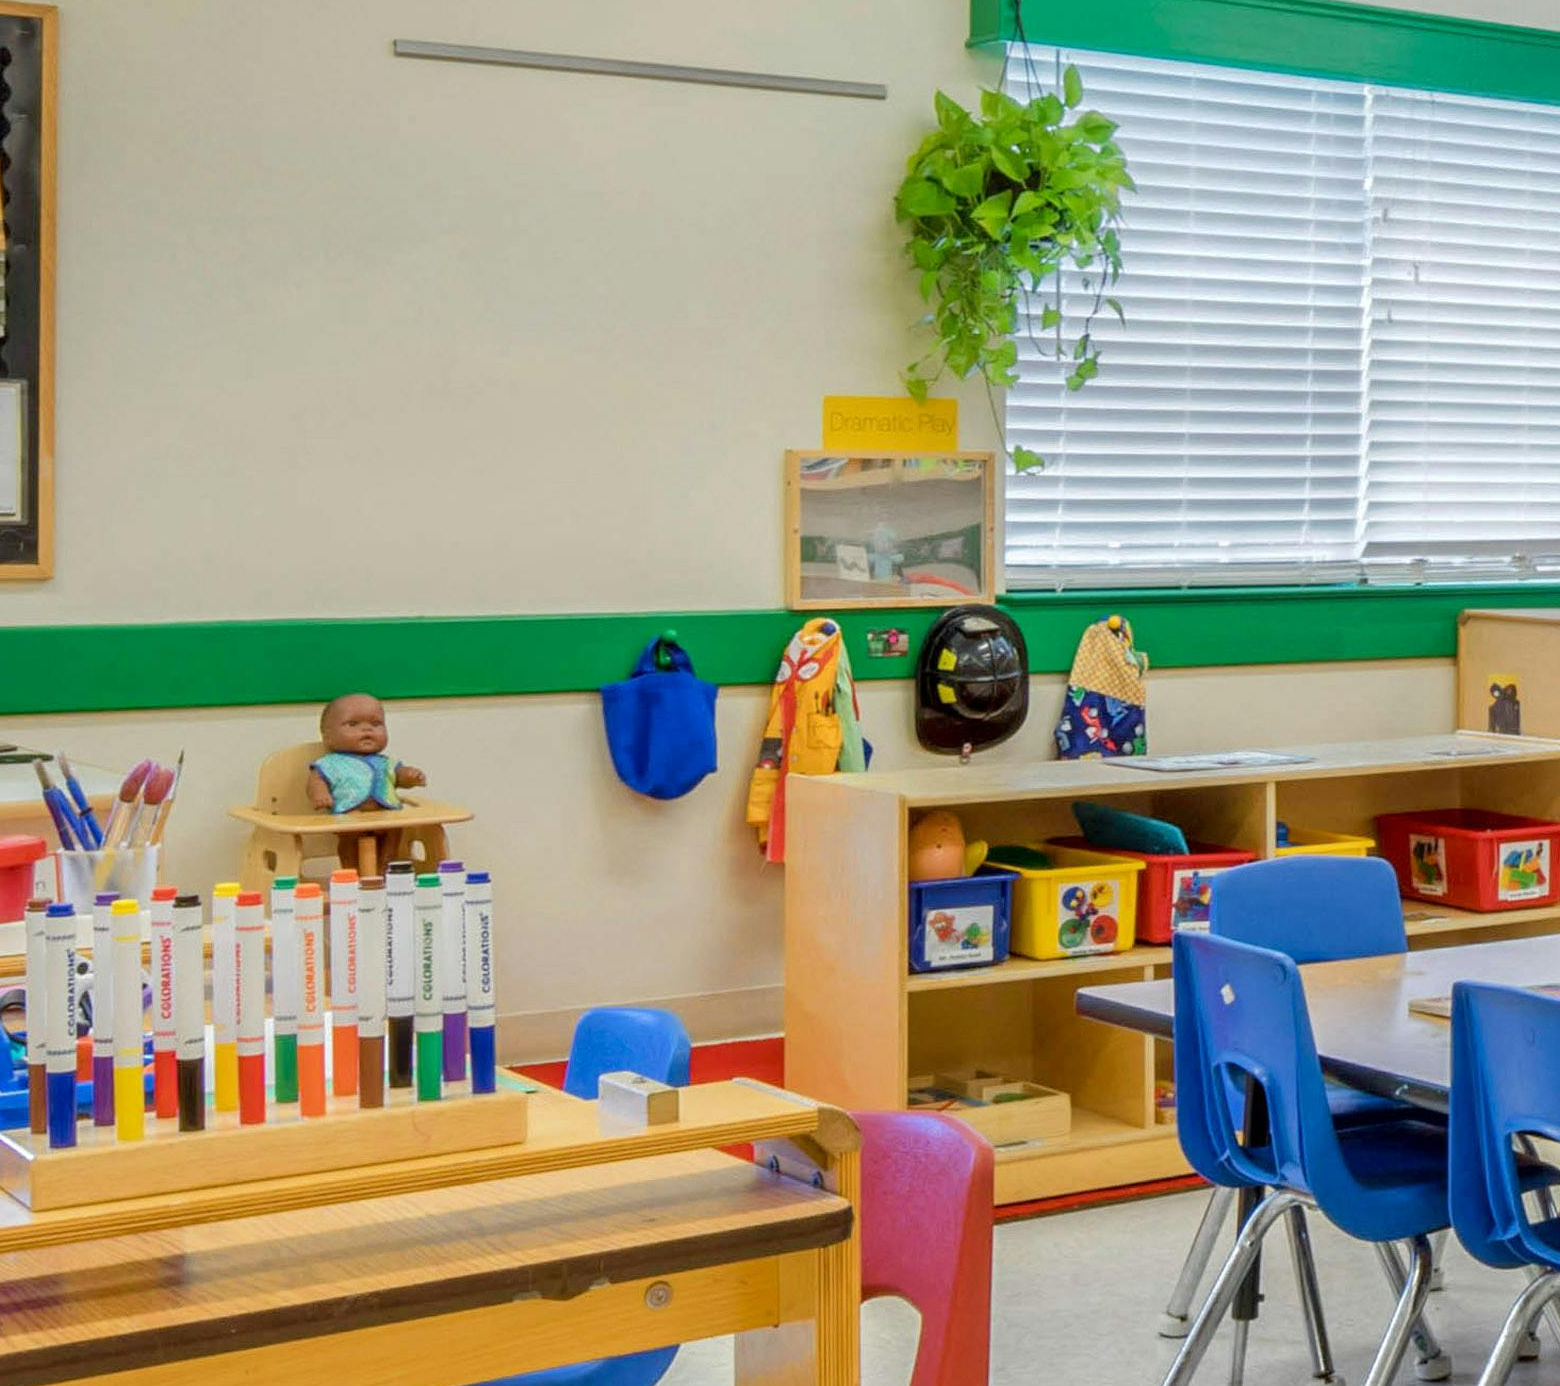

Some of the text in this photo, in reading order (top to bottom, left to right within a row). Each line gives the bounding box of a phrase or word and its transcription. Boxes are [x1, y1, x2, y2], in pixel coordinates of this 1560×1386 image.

[829, 412, 954, 435] Dramatic Play
[160, 936, 173, 1020] COLORATIONS
[304, 931, 316, 1013] COLORATIONS
[422, 921, 434, 1001] COLORATIONS
[480, 914, 490, 994] COLORATIONS
